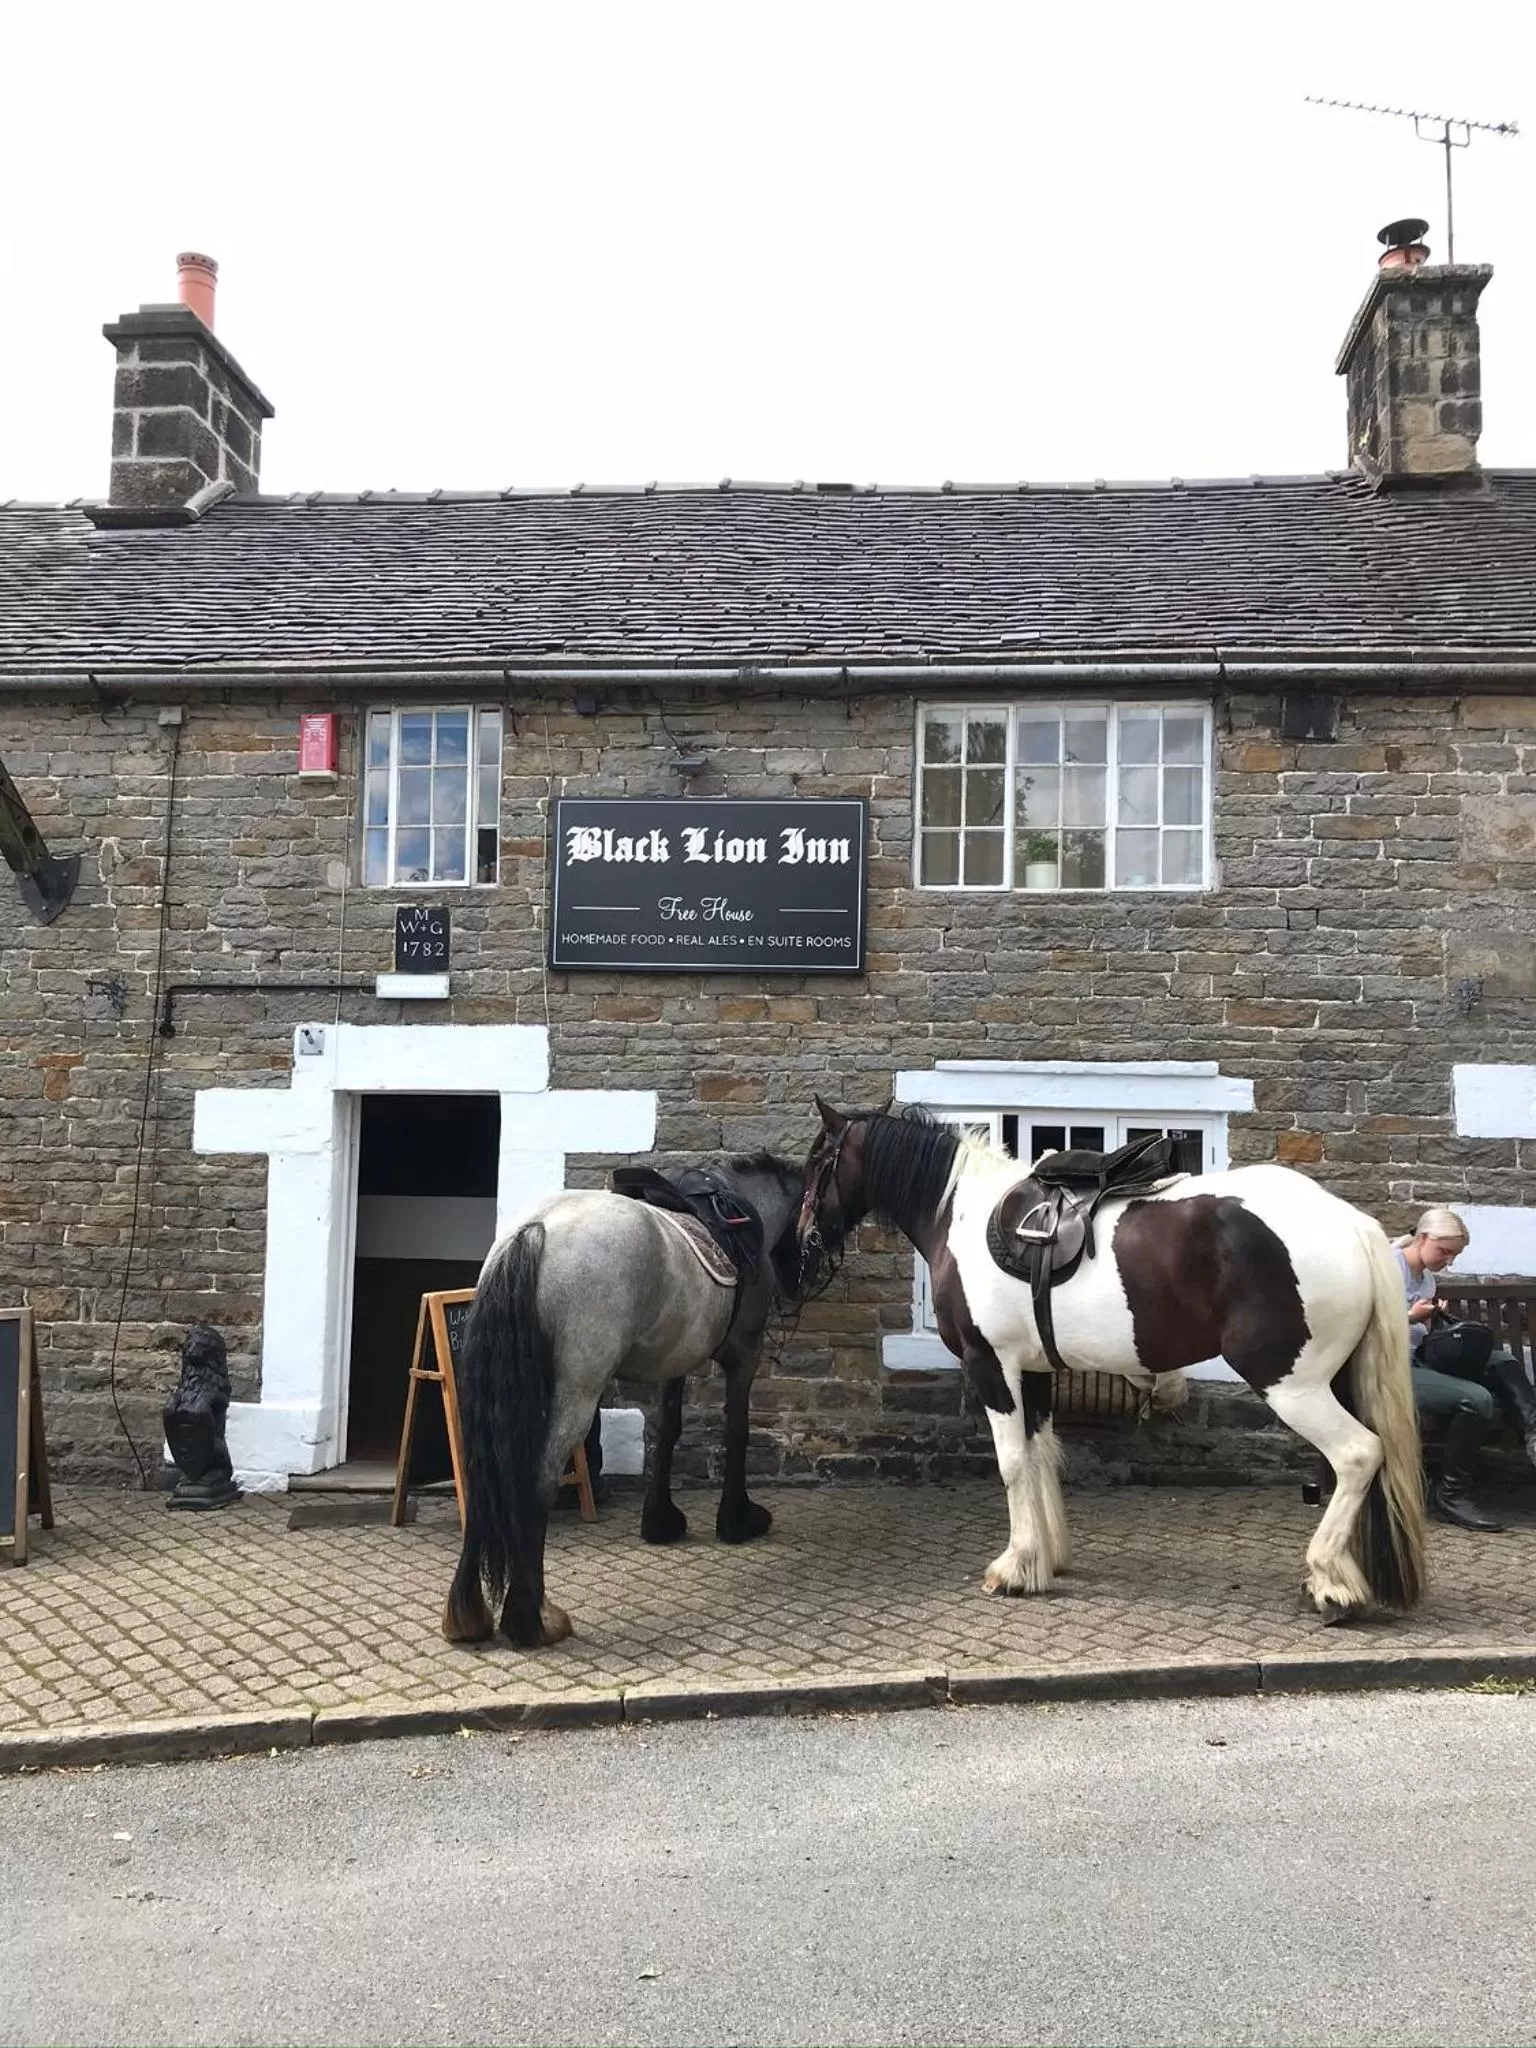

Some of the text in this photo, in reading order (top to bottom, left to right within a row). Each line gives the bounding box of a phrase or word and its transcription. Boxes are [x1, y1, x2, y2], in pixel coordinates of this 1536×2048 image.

[566, 826, 851, 866] Black Lion Inn
[414, 909, 428, 921] M
[657, 896, 753, 922] Free House
[561, 933, 851, 948] HOMEMADE FOOD REAL ALES EN SUITE ROOMS
[403, 941, 444, 957] 1782
